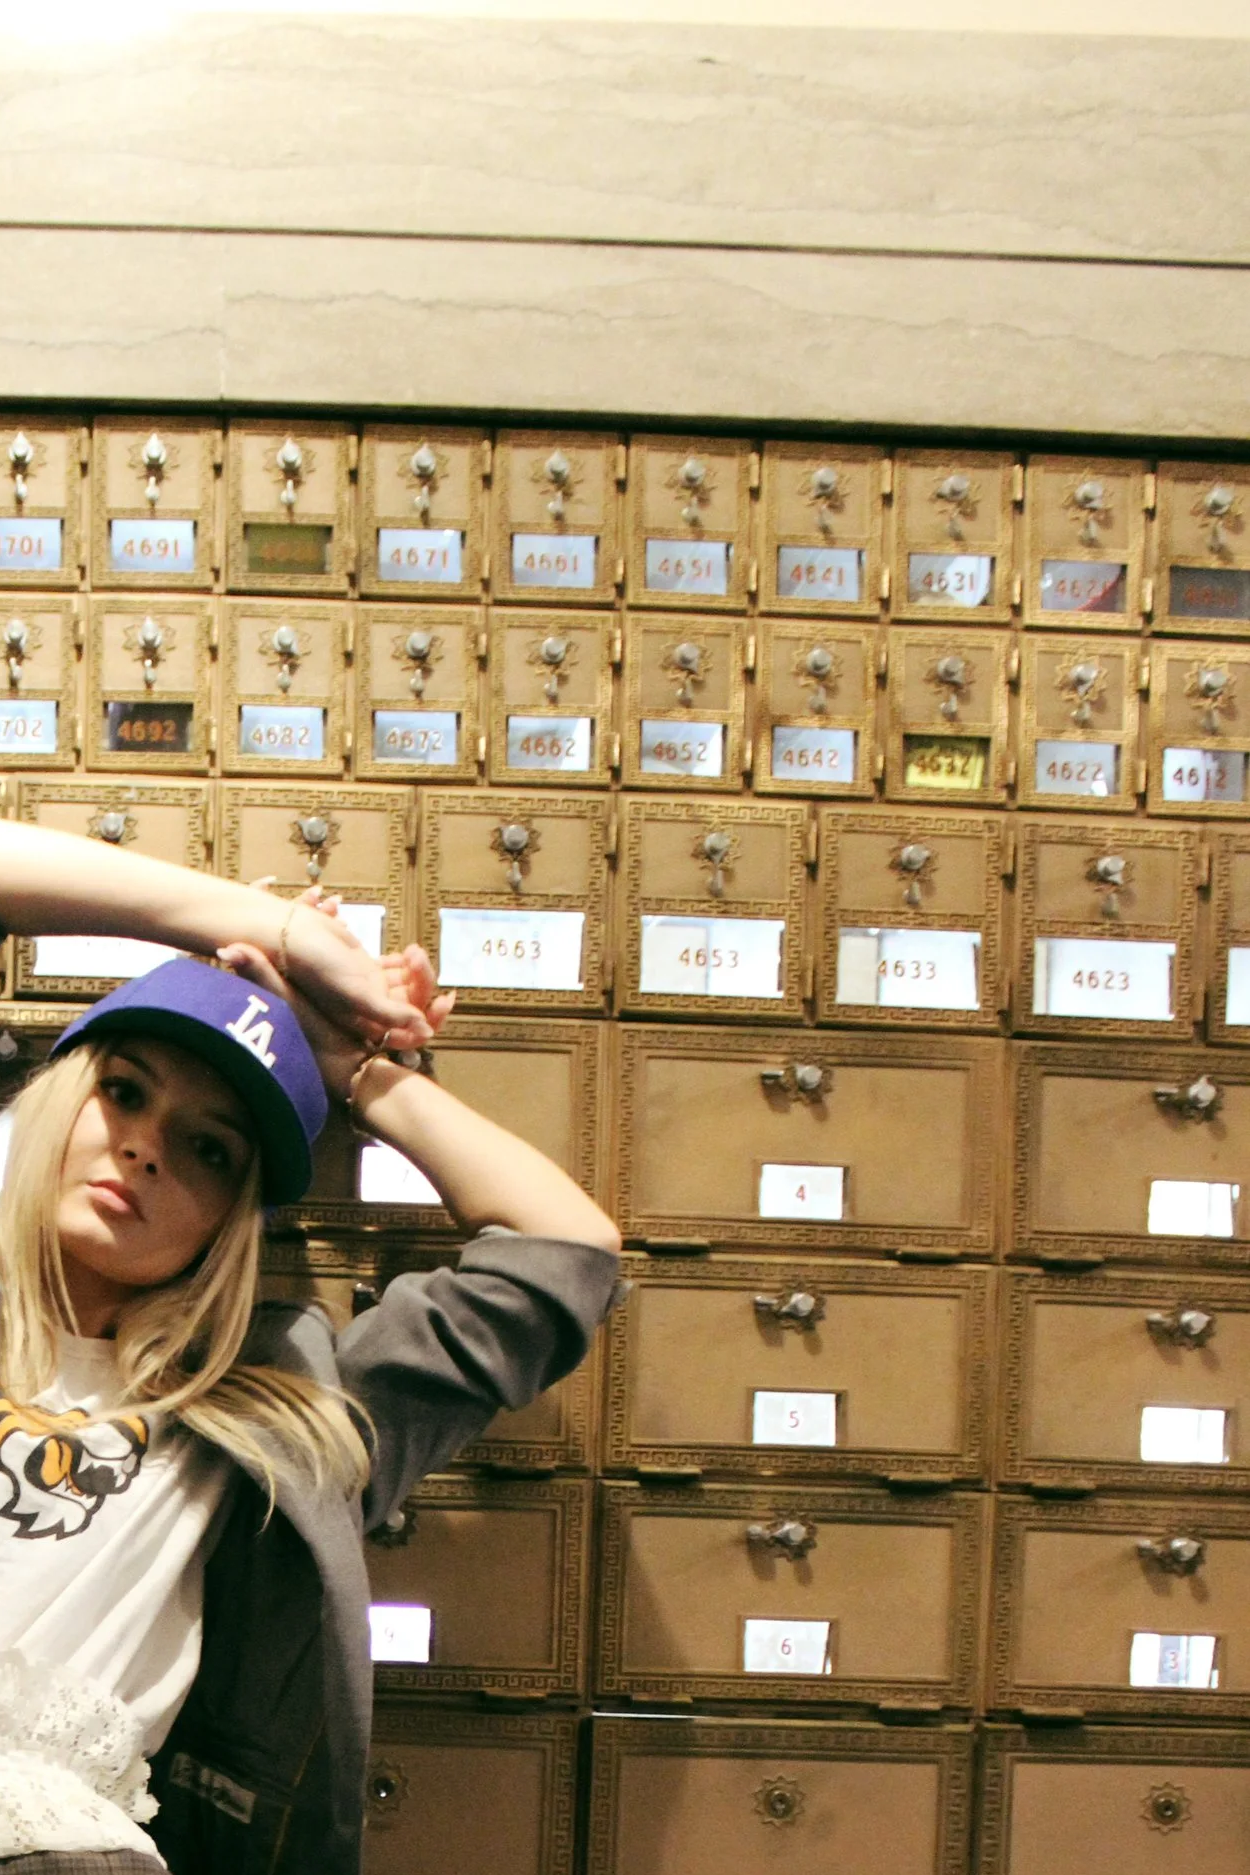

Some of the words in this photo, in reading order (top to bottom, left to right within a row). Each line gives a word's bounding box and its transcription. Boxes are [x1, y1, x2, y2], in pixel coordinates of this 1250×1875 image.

[122, 538, 179, 559] 4691
[390, 548, 448, 569] 4671
[524, 554, 578, 574] 4661
[658, 557, 712, 578] 4651
[790, 564, 846, 587] 4641
[922, 572, 975, 592] 4631
[118, 720, 176, 741] 4692
[252, 725, 311, 746] 4682
[387, 729, 443, 750] 4672
[520, 737, 576, 757] 4662
[653, 741, 707, 761] 4652
[783, 749, 839, 768] 4642
[1046, 761, 1102, 780] 4622
[482, 939, 542, 959] 4663
[679, 947, 739, 968] 4653
[877, 960, 937, 980] 4633
[1072, 970, 1130, 990] 4623
[225, 994, 276, 1069] LA
[796, 1185, 806, 1201] 4
[789, 1411, 799, 1428] 5
[780, 1638, 791, 1655] 6
